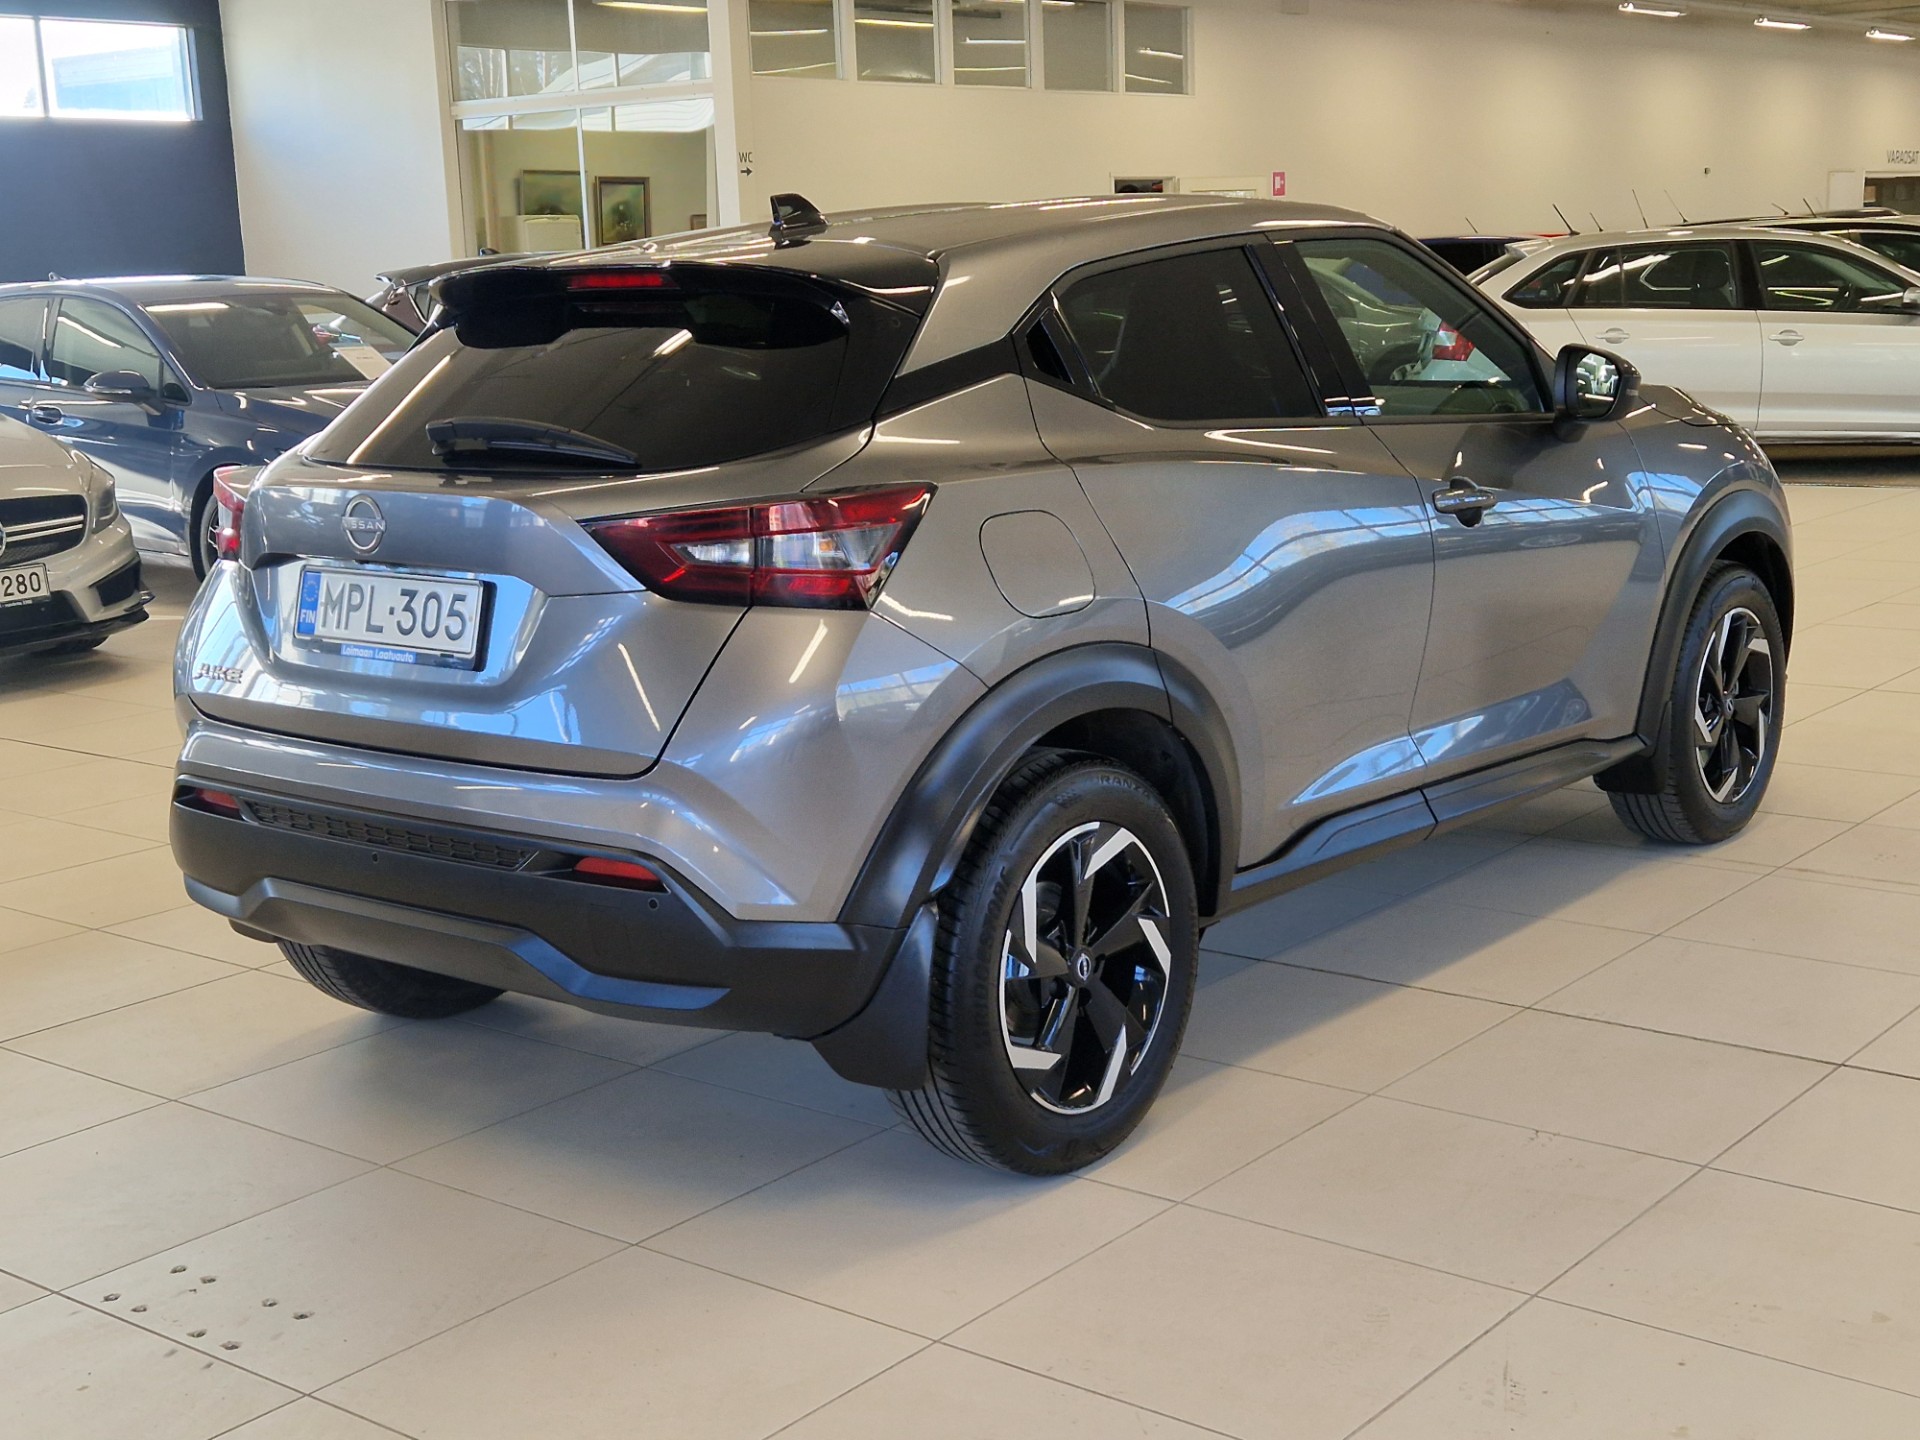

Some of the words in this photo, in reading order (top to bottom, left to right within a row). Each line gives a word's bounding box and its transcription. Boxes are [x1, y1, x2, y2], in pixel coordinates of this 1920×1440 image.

[738, 151, 753, 163] WC
[1, 571, 41, 597] 280
[300, 609, 316, 624] FIN
[193, 662, 243, 684] JUKE
